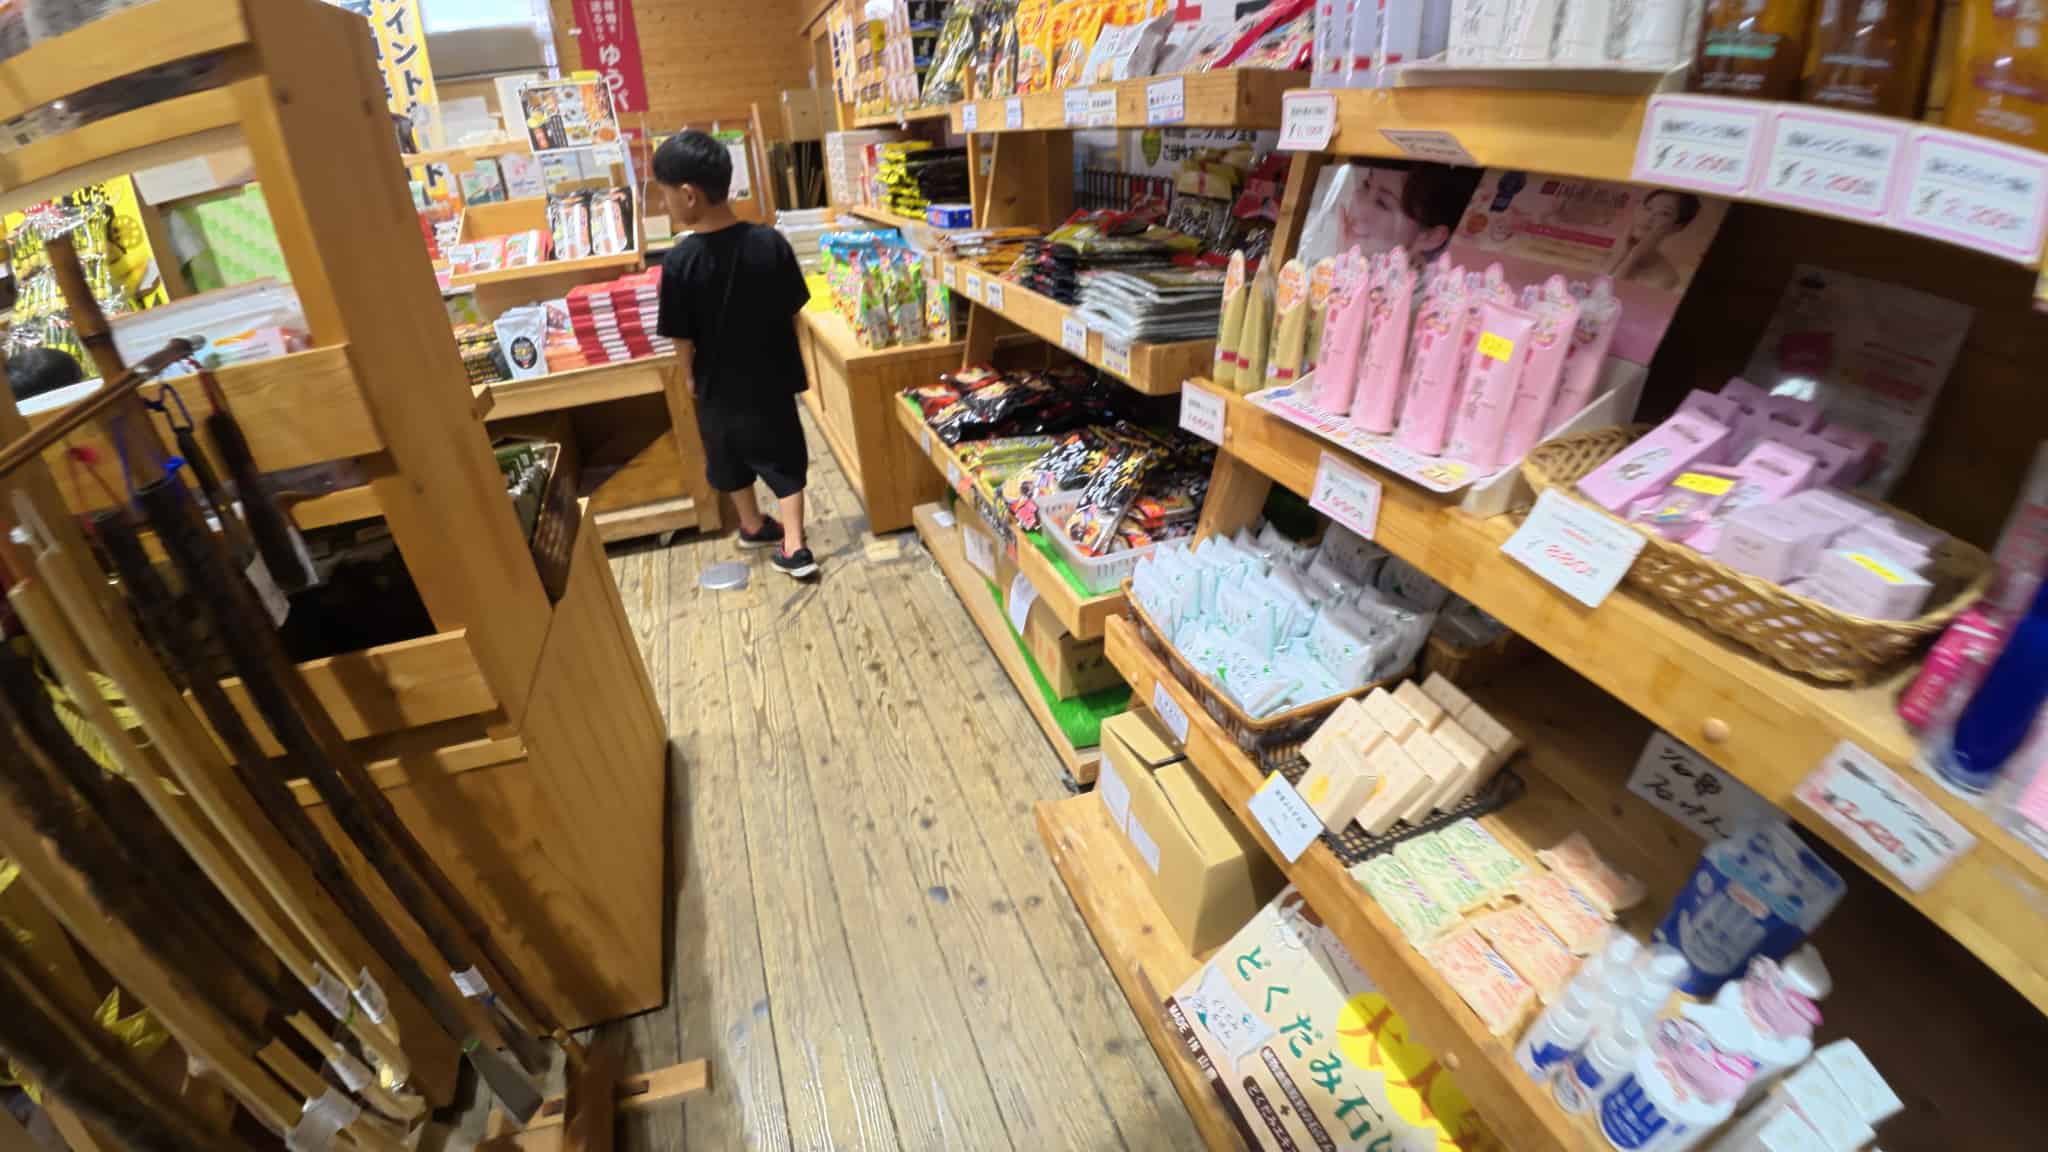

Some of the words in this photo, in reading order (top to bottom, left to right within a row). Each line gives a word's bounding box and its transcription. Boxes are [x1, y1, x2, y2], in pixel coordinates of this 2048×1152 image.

[1236, 944, 1406, 1152] どくだみ石
